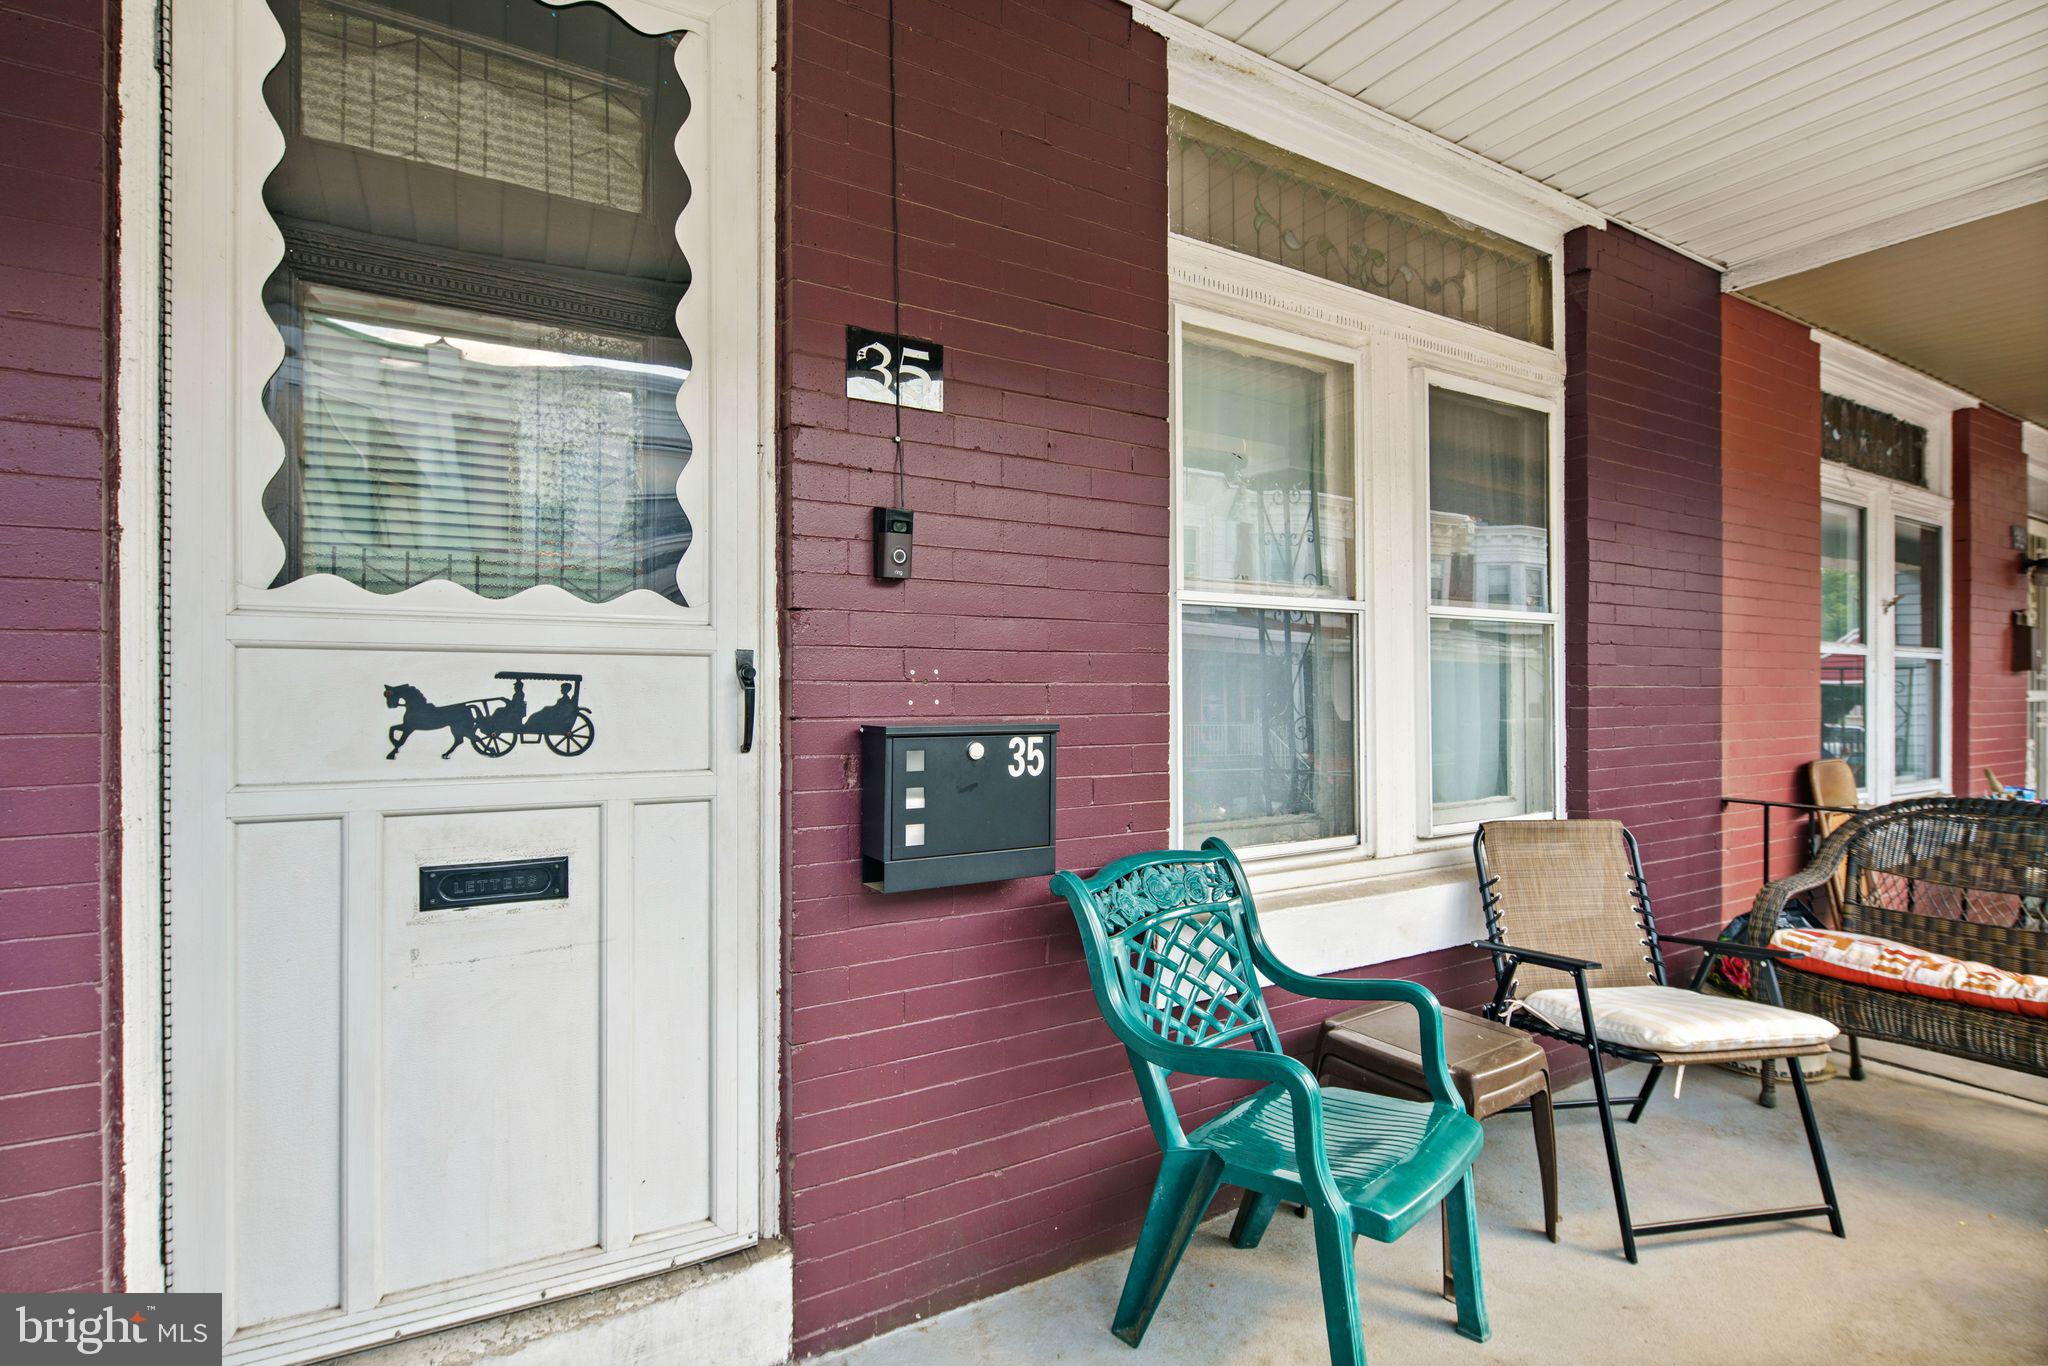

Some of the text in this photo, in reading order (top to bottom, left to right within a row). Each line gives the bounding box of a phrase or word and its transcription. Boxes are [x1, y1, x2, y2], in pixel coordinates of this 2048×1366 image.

[856, 341, 932, 398] 35
[1008, 736, 1044, 777] 35
[453, 875, 538, 895] LETTERS
